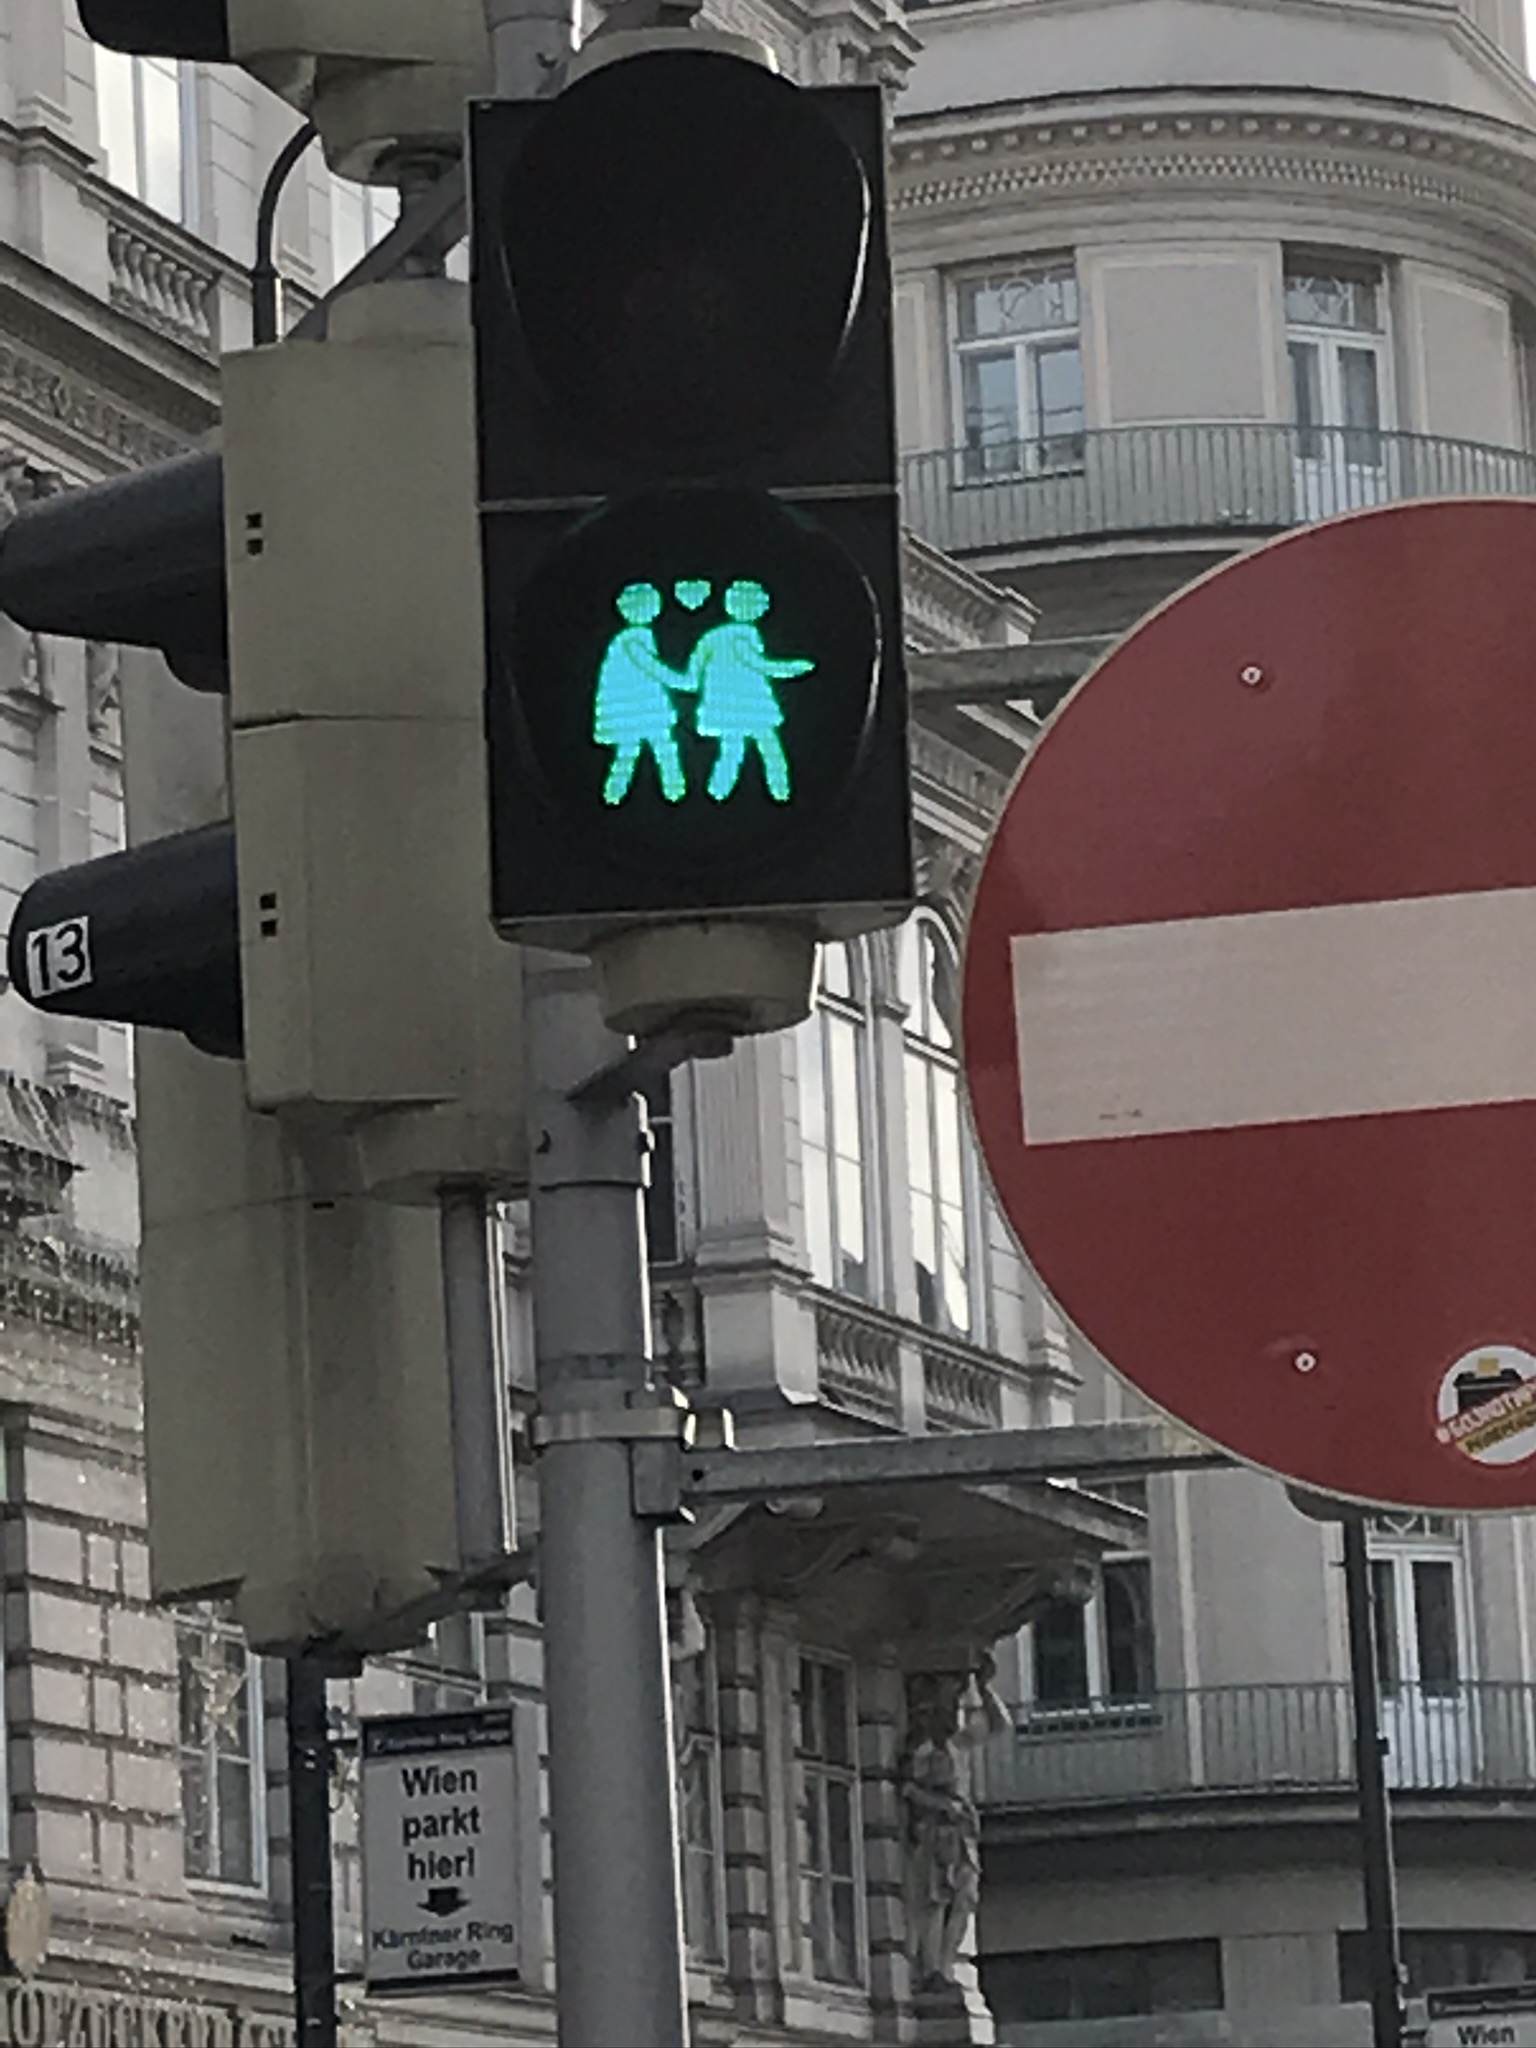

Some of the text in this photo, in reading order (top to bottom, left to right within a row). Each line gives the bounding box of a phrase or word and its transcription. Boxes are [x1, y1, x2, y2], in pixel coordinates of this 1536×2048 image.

[32, 923, 86, 991] 13
[402, 1765, 477, 1798] Wien
[402, 1806, 481, 1847] parkt
[467, 1921, 514, 1944] Ring
[406, 1948, 482, 1971] Garage
[1457, 2024, 1515, 2045] Wien
